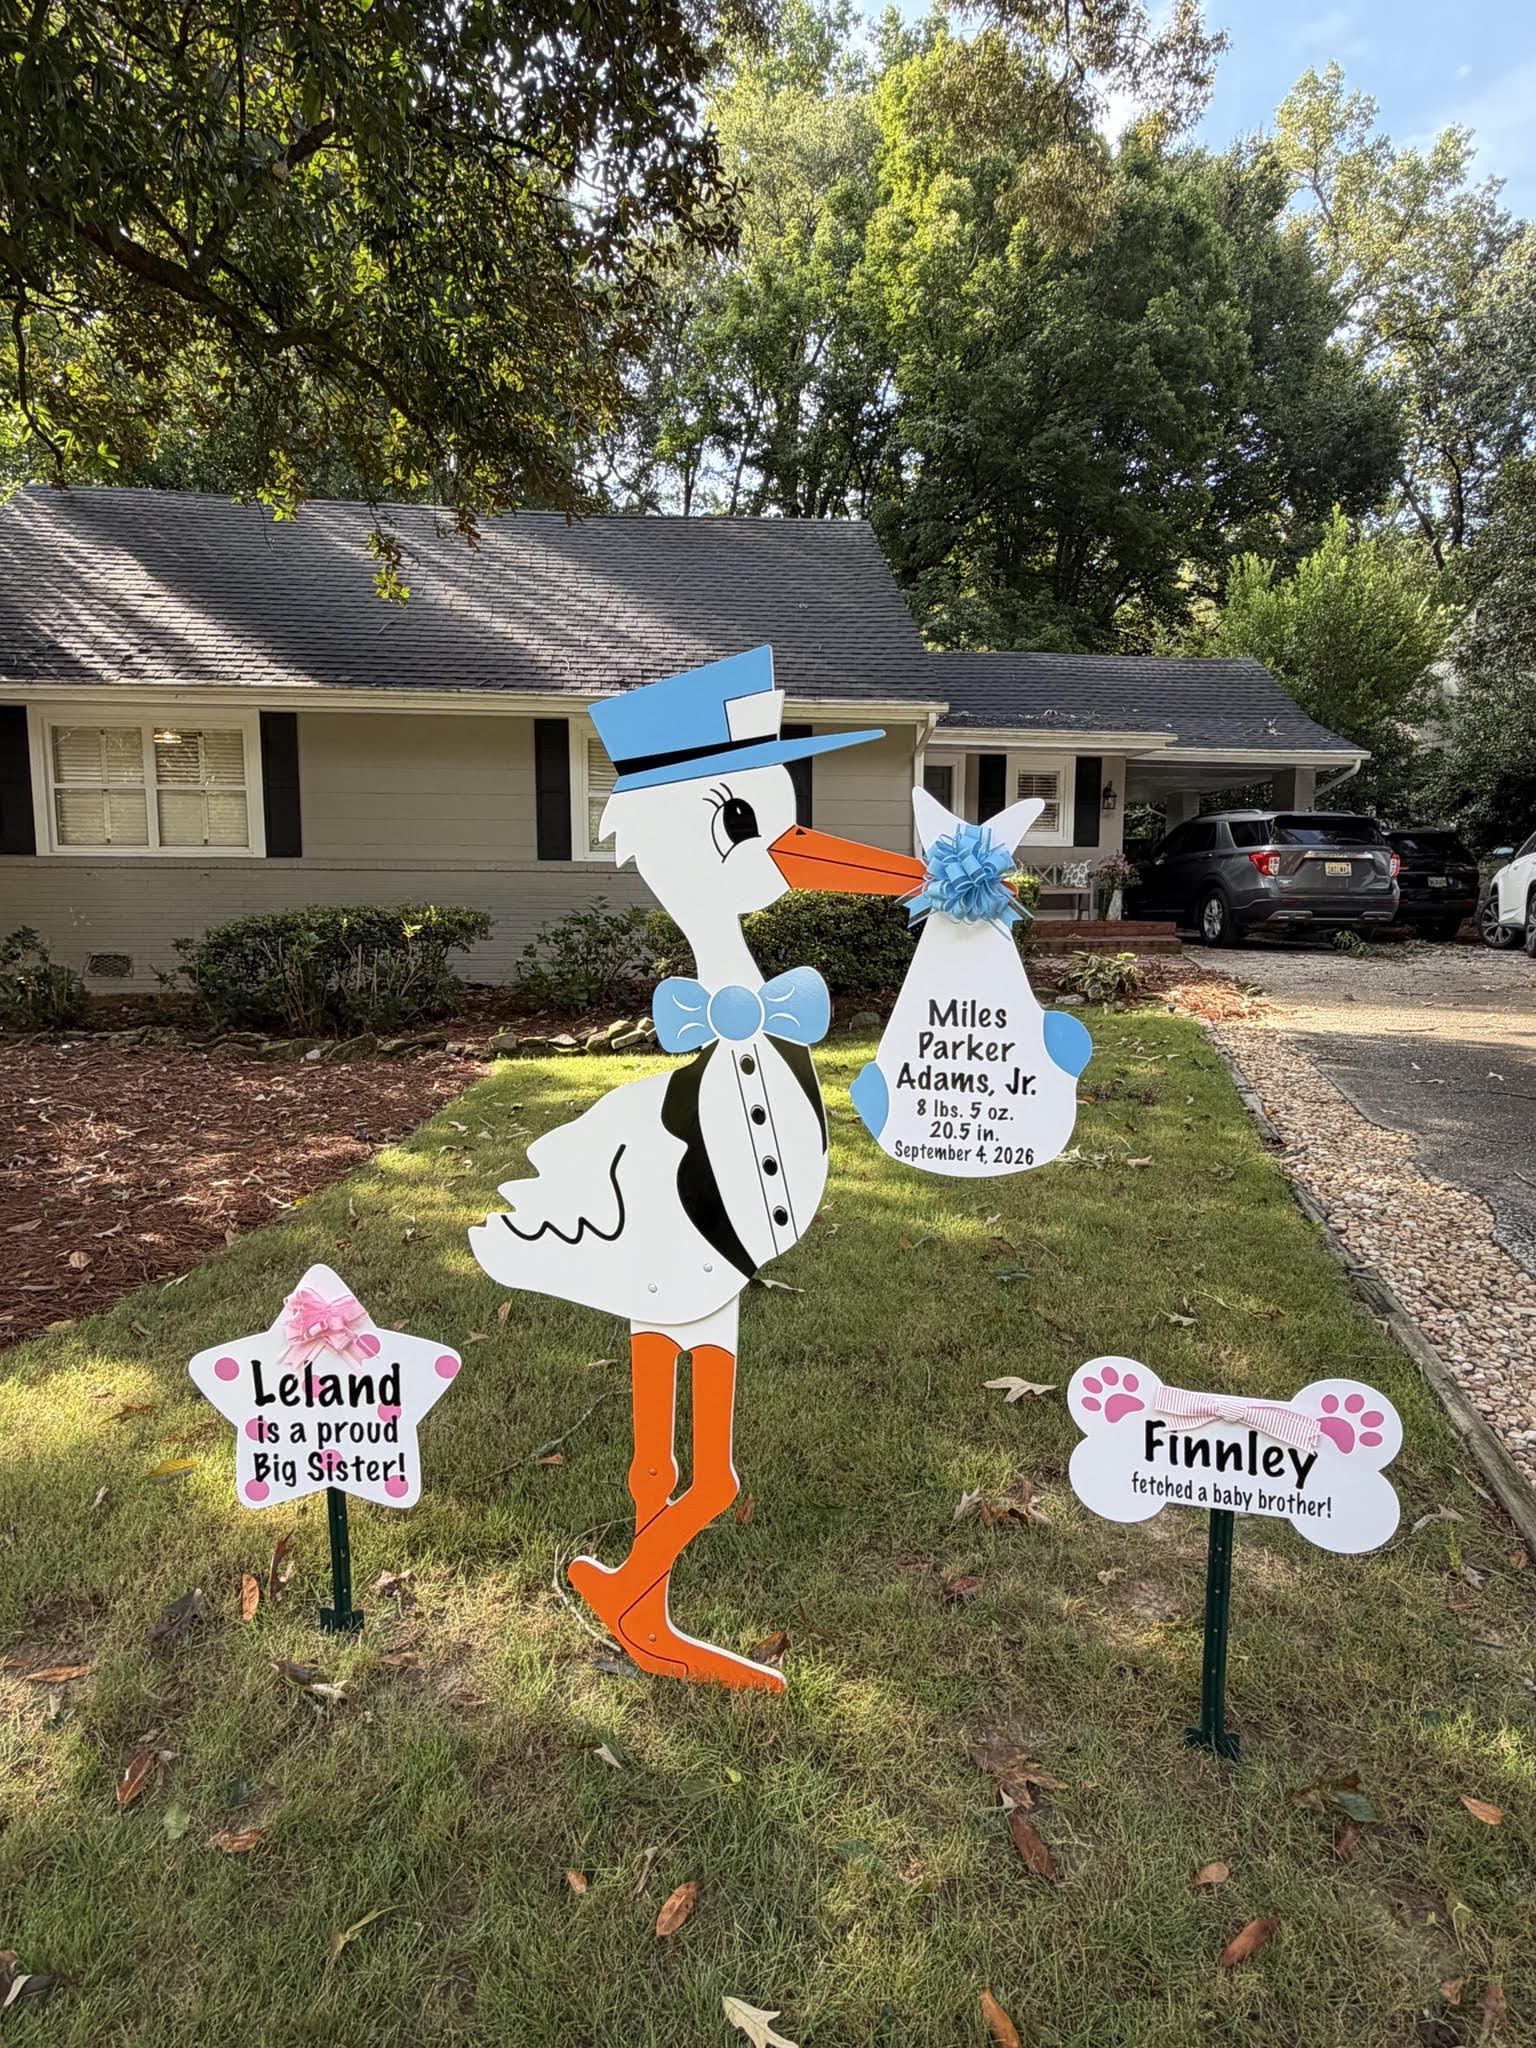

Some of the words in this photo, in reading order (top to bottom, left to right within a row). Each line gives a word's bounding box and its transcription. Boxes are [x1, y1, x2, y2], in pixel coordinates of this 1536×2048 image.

[929, 999, 1007, 1028] Miles
[919, 1032, 1015, 1062] Parker
[897, 1063, 995, 1097] Adams,
[1005, 1067, 1037, 1095] Jr.
[917, 1099, 927, 1116] 8
[934, 1100, 963, 1118] lbs.
[970, 1102, 982, 1119] 5
[988, 1108, 1014, 1121] oz.
[930, 1121, 971, 1140] 20.5
[977, 1124, 999, 1142] in.
[895, 1140, 972, 1161] September
[976, 1145, 988, 1164] 4,
[993, 1147, 1034, 1165] 2026
[251, 1360, 401, 1408] Leland
[257, 1415, 280, 1443] is
[290, 1423, 307, 1443] a
[318, 1415, 399, 1450] proud
[254, 1453, 297, 1487] Big
[307, 1452, 406, 1482] Sister!
[1145, 1419, 1318, 1489] Finnley
[1132, 1472, 1193, 1500] fetched
[1198, 1486, 1208, 1502] a
[1214, 1483, 1253, 1511] baby
[1259, 1489, 1332, 1519] brother!
